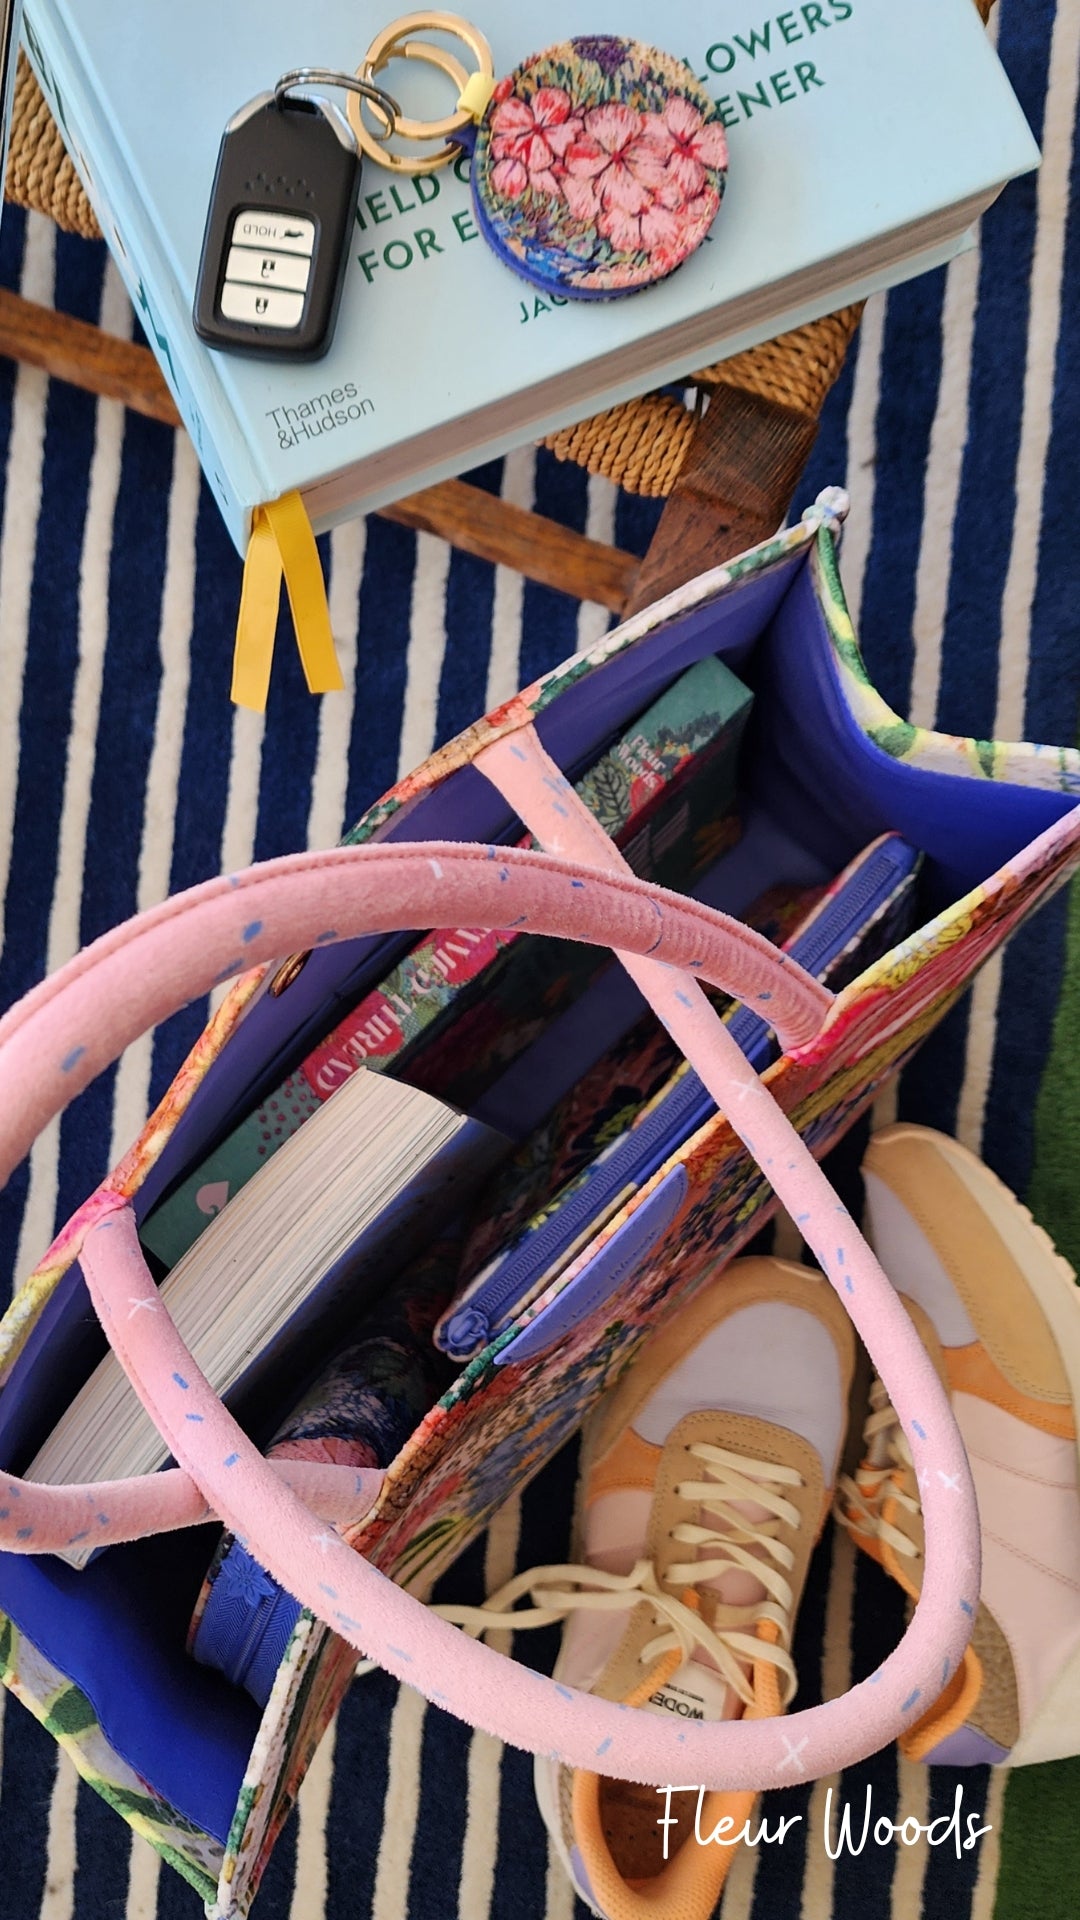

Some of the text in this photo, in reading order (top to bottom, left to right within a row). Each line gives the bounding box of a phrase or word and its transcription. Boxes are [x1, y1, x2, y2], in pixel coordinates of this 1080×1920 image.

[355, 172, 441, 231] IELD
[682, 0, 853, 83] LOWERS
[357, 61, 826, 283] FOR ENER
[243, 223, 277, 238] HOLD
[265, 382, 358, 429] Thames
[277, 398, 375, 450] &Hudson
[617, 743, 656, 789] Woods
[630, 734, 667, 771] Fleur
[316, 993, 414, 1091] THREAD
